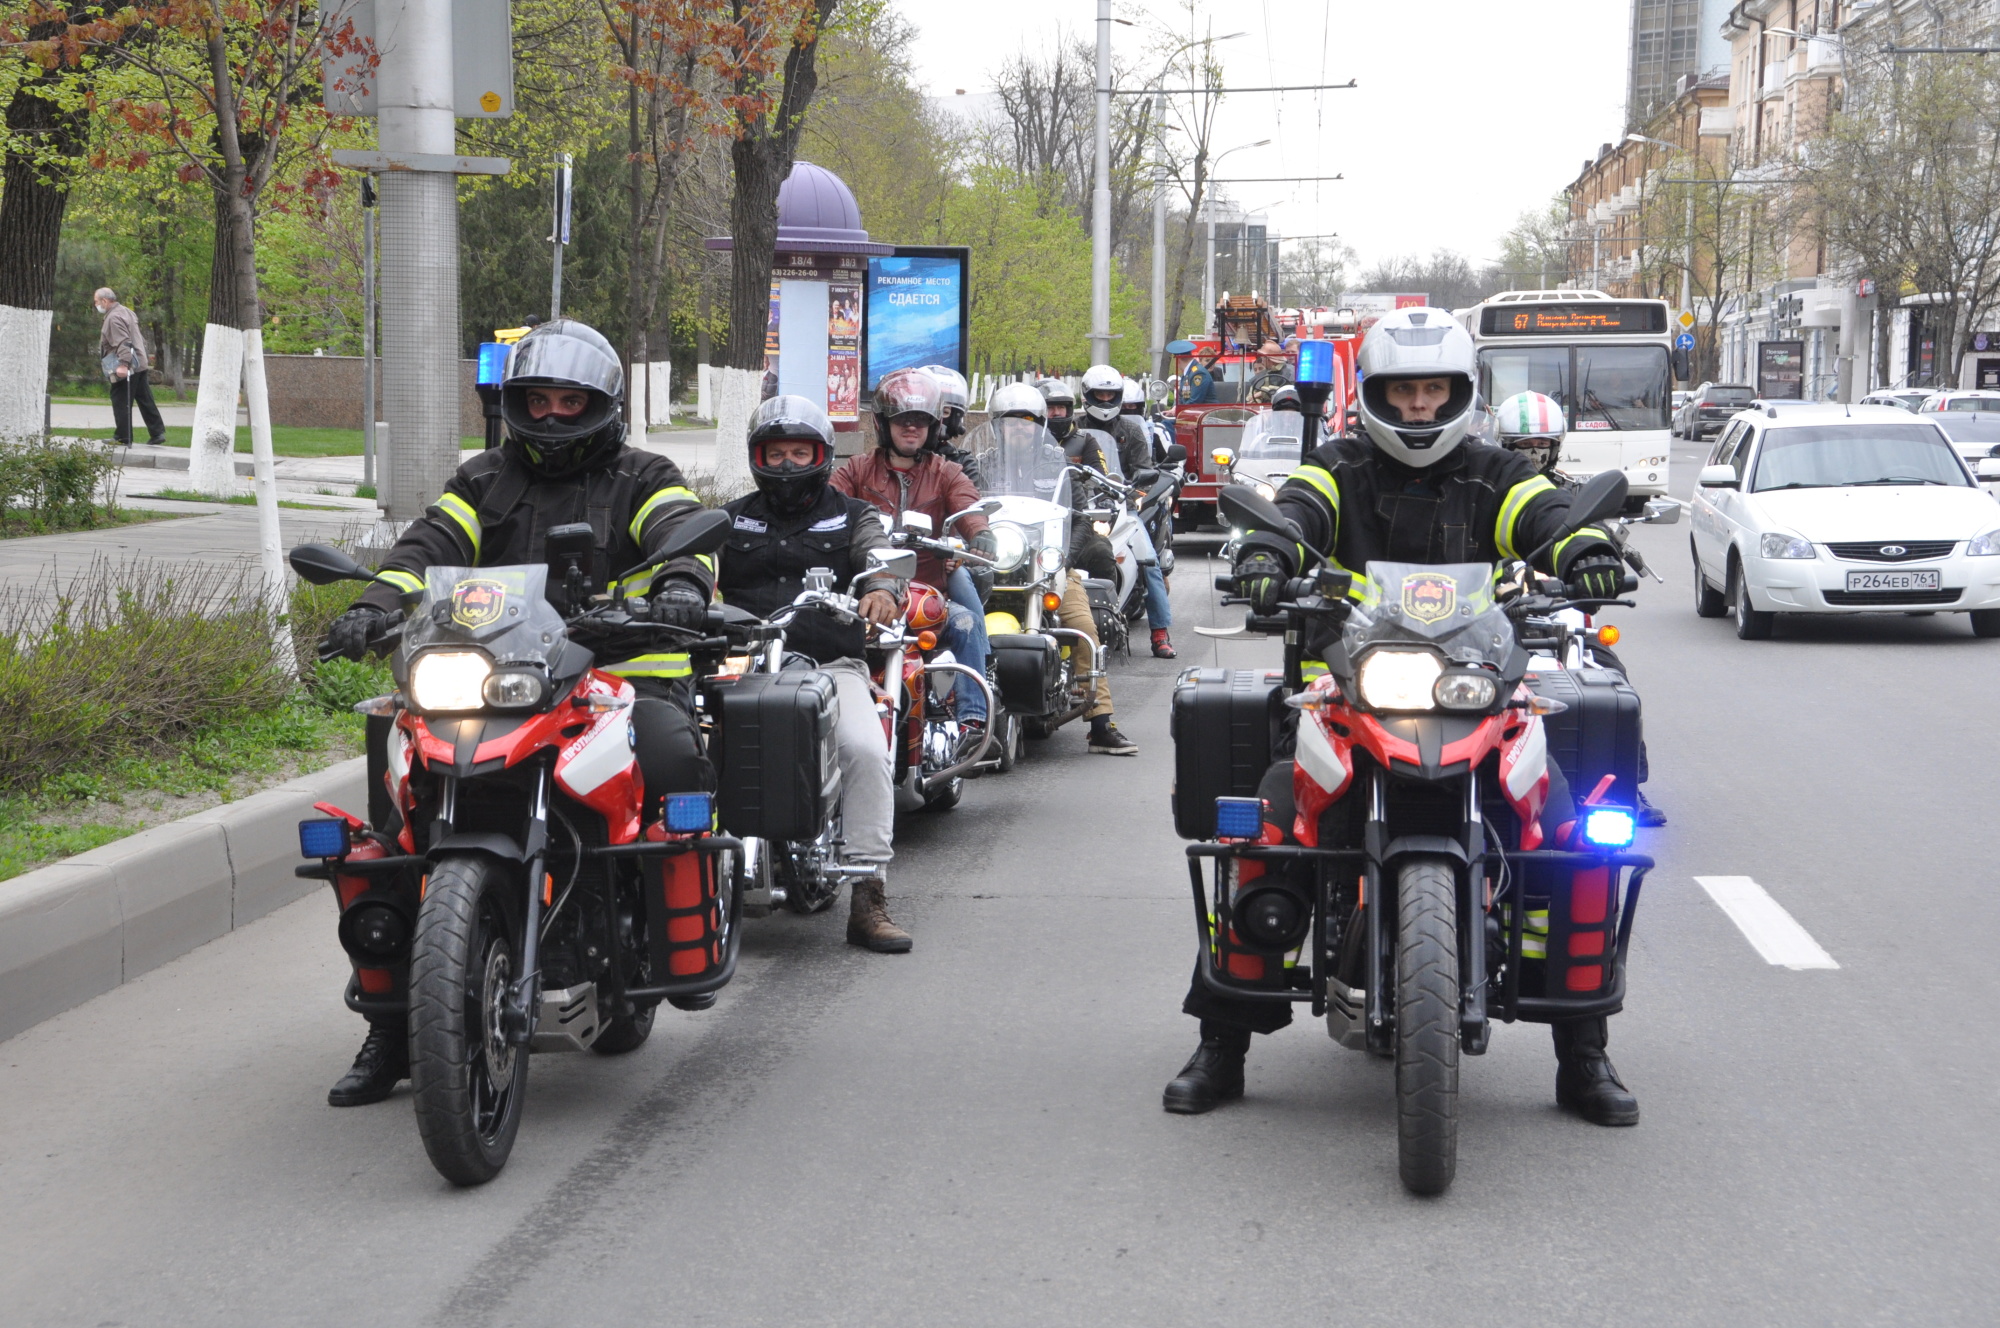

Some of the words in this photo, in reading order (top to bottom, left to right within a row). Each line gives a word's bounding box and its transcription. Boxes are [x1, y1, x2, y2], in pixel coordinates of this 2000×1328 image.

[791, 256, 813, 266] 18/4
[841, 258, 856, 267] 18/3
[782, 269, 818, 277] 226-26-00
[877, 276, 923, 285] РЕКЛАМНОЕ
[925, 277, 951, 286] МЕСТО
[888, 292, 940, 307] СДАЕТСЯ
[1514, 314, 1529, 329] 67
[1585, 421, 1612, 429] САДОВА
[1853, 574, 1910, 588] Р264ЕВ
[1912, 573, 1935, 584] 761
